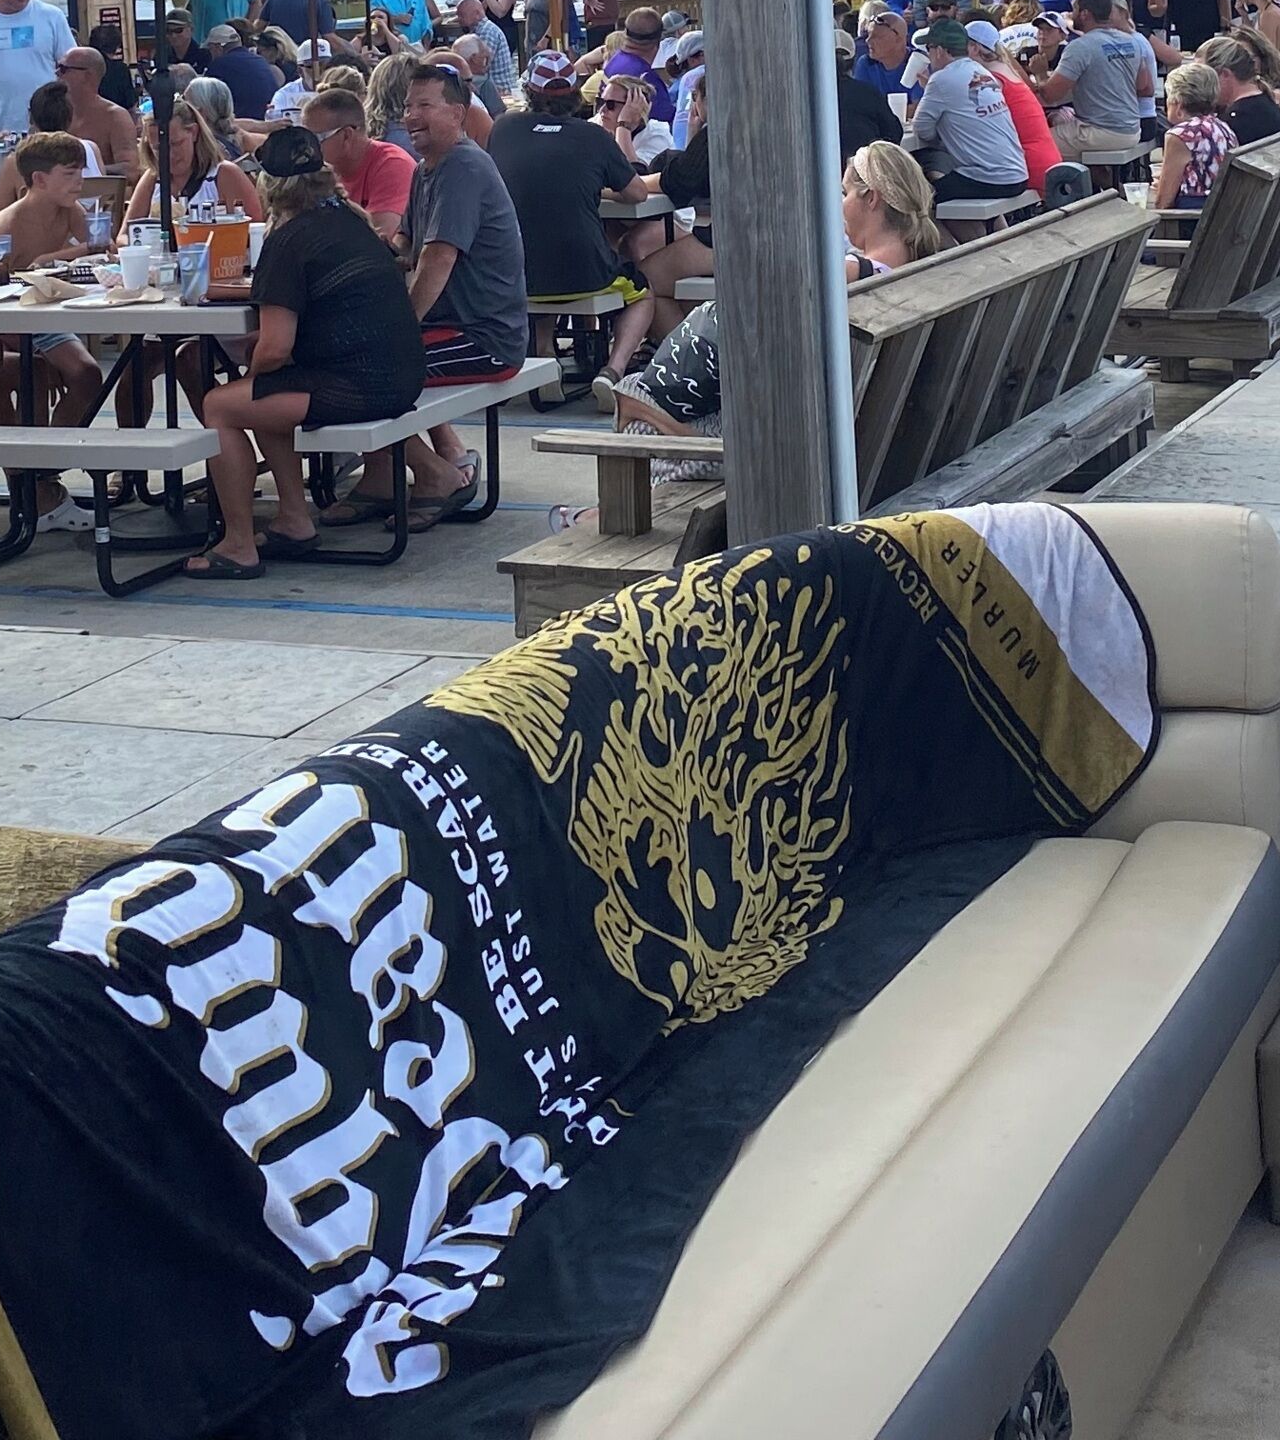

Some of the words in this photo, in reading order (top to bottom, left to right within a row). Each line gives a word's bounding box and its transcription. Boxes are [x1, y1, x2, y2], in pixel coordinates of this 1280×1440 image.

[856, 530, 938, 624] RECYCLE
[420, 739, 509, 887] WATER
[482, 938, 529, 1035] BE
[506, 909, 560, 1016] JUST
